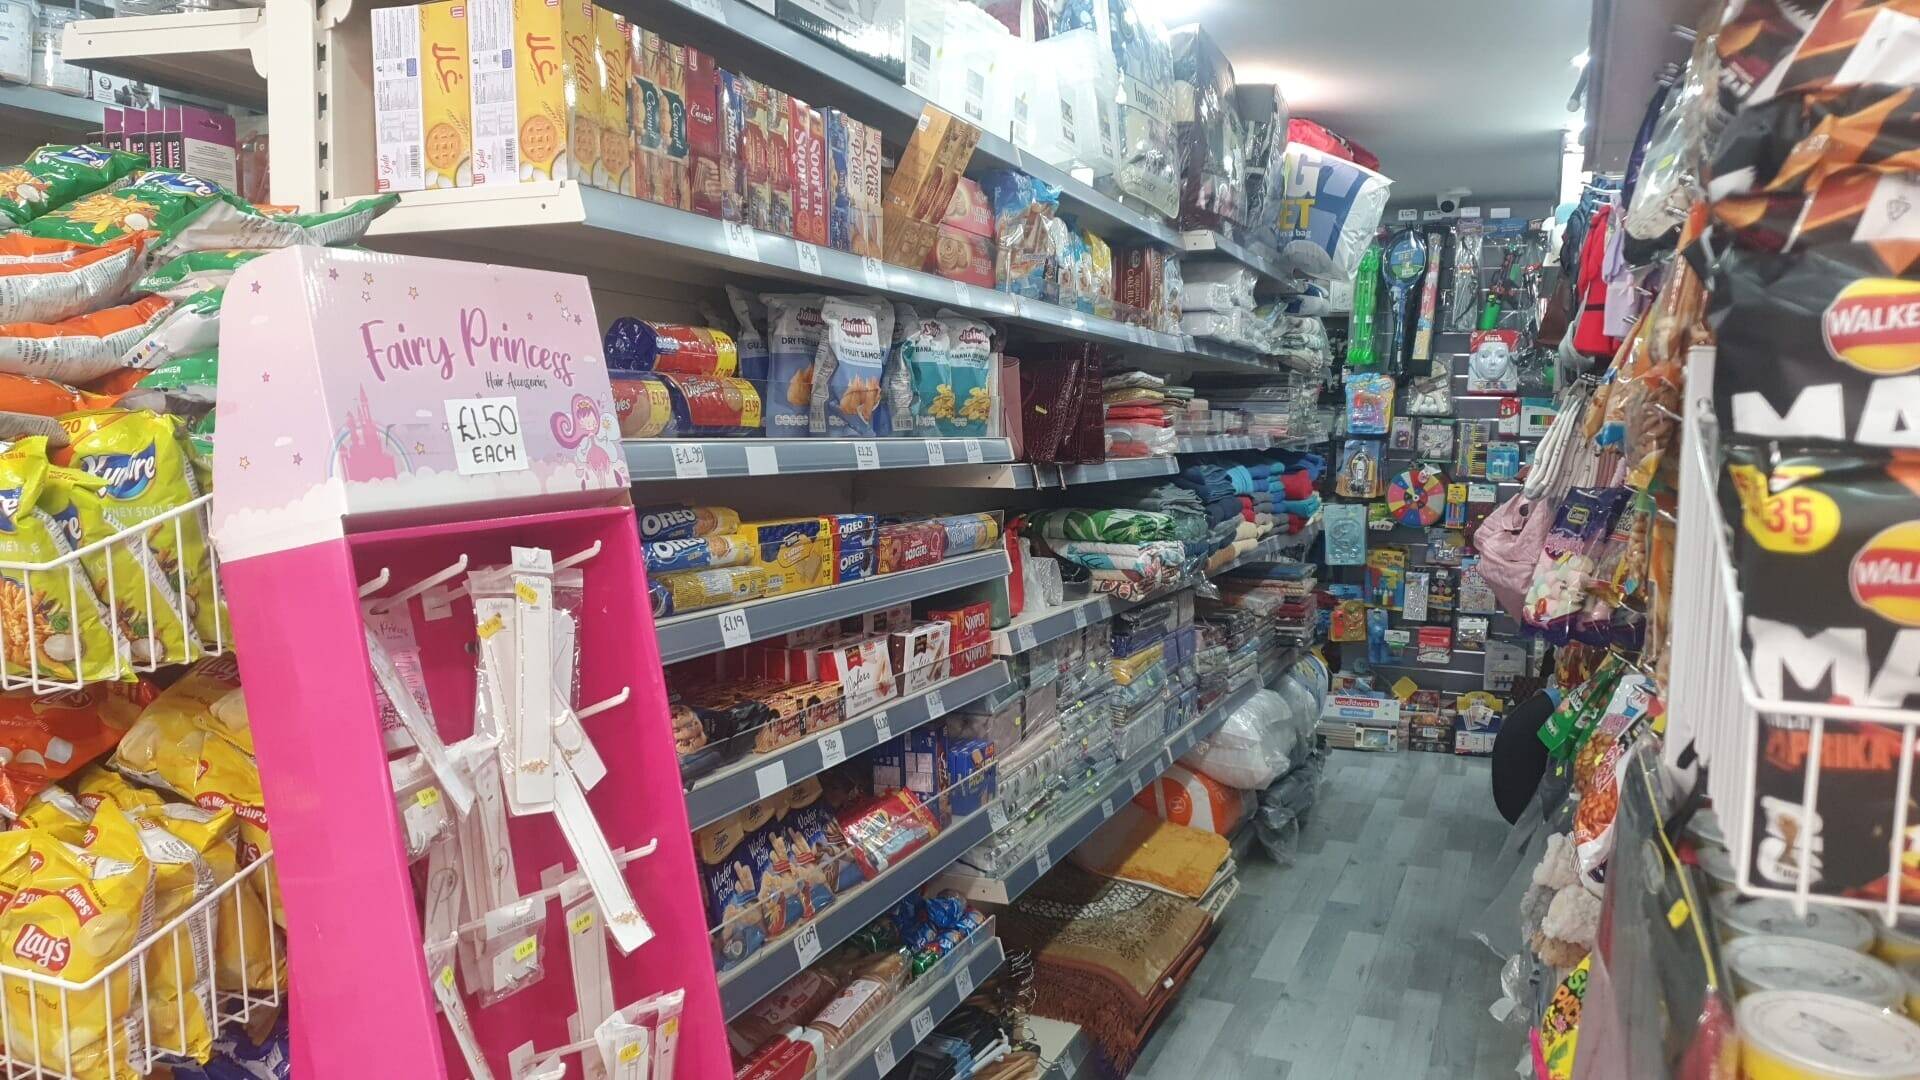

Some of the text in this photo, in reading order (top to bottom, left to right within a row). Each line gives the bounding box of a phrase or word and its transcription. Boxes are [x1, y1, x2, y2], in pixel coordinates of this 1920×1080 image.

[361, 307, 574, 387] Fairy Princess
[486, 372, 548, 391] Hair Accessories
[458, 404, 518, 442] £1.50
[472, 444, 516, 465] EACH
[676, 447, 704, 465] £1.99
[642, 509, 696, 536] OREO
[840, 520, 863, 538] OREO
[653, 537, 706, 560] OREO
[841, 552, 864, 572] OREO
[723, 615, 744, 632] £1.19
[236, 807, 268, 824] CHIPS
[748, 832, 767, 860] Wafer
[712, 861, 732, 892] Wafer
[16, 923, 68, 967] Lay's
